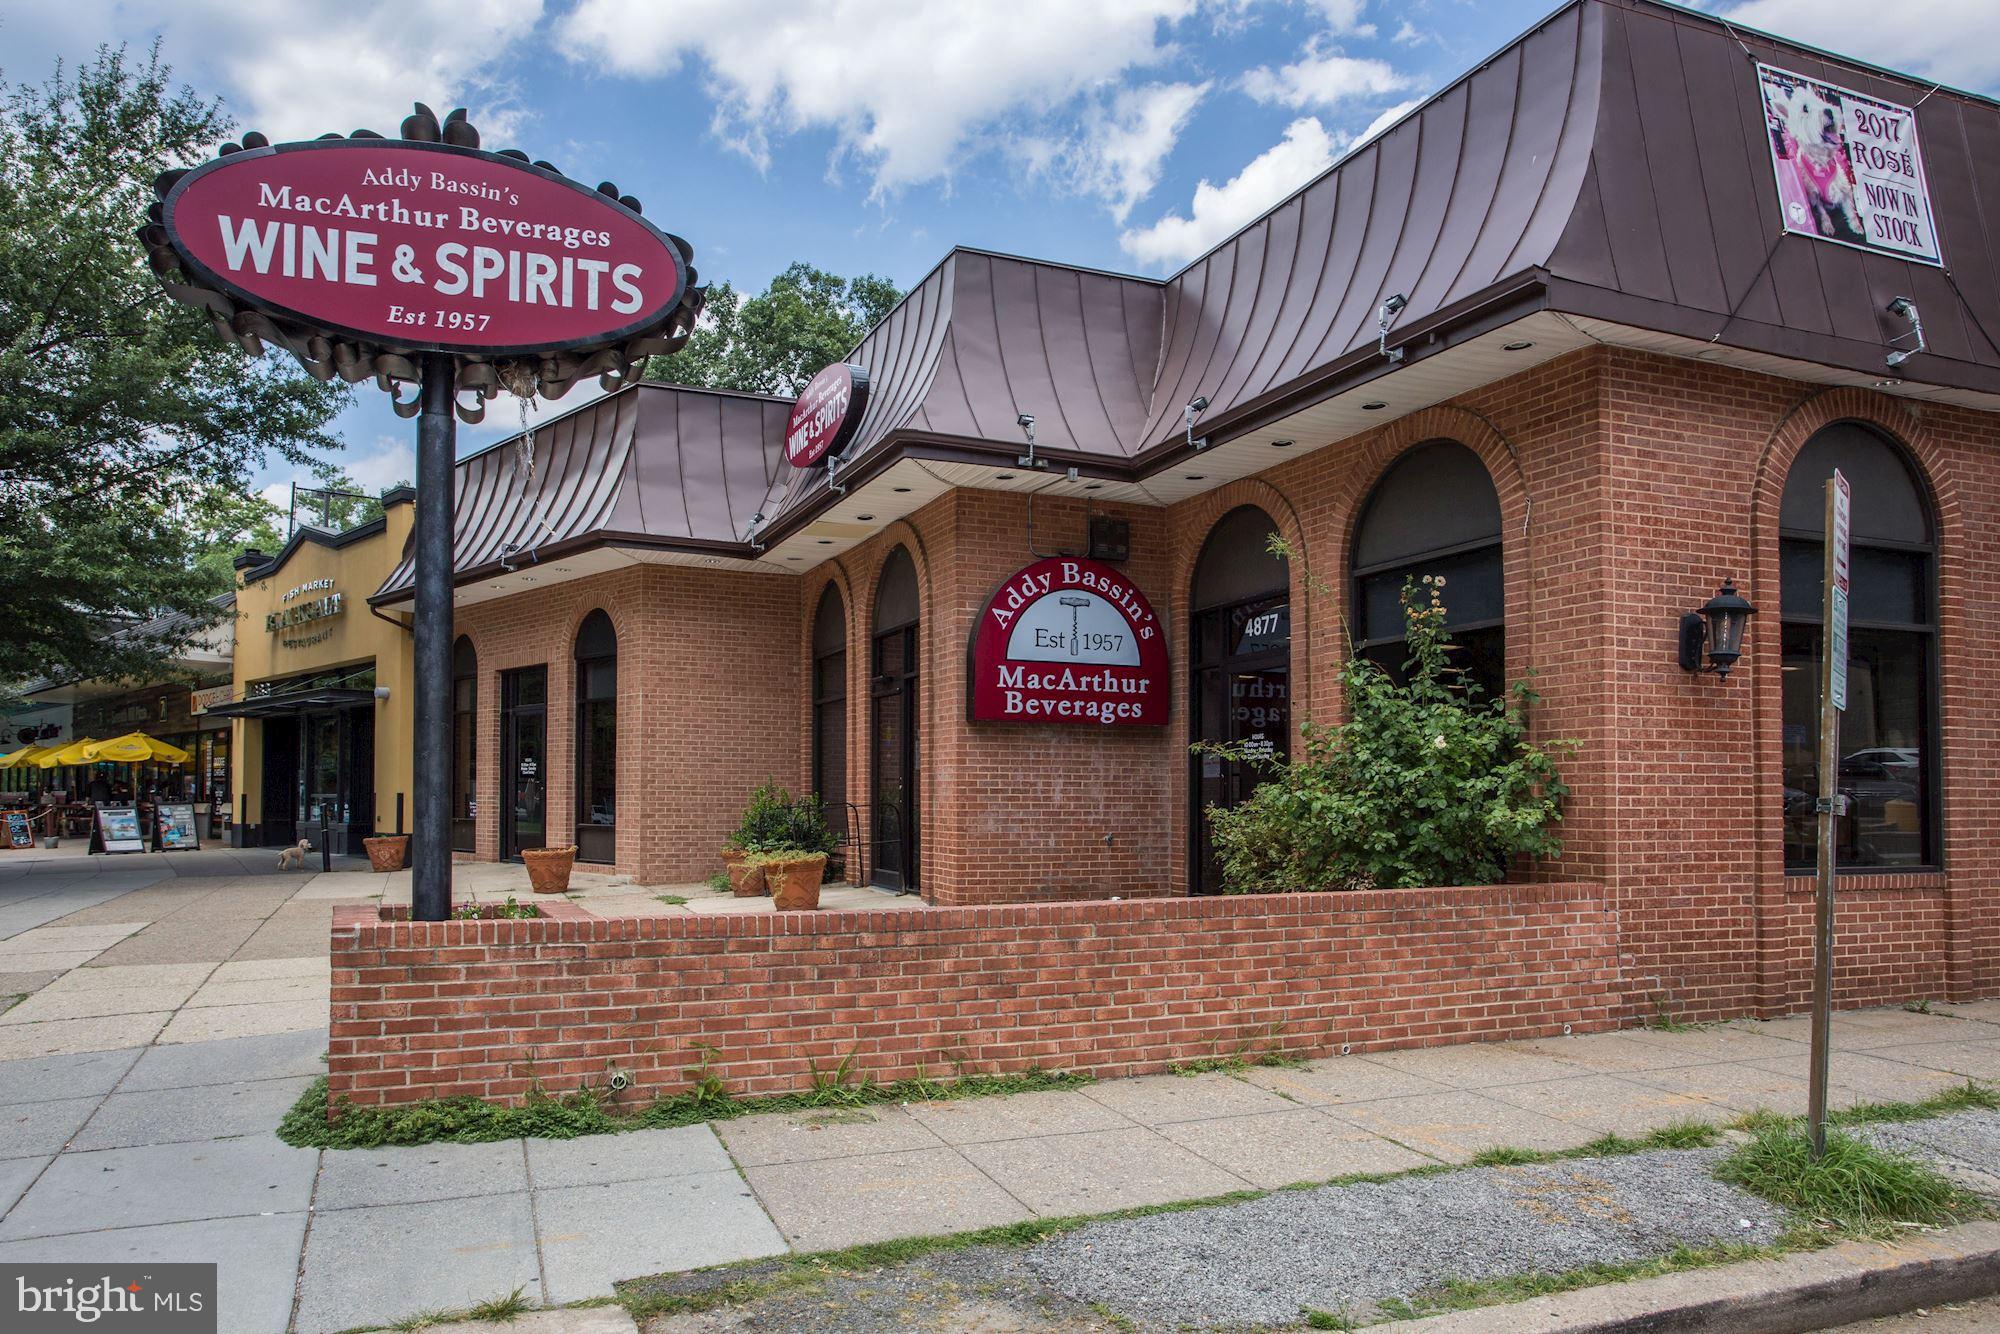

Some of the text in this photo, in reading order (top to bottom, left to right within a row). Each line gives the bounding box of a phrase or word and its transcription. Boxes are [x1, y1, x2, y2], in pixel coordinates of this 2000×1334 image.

[1854, 109, 1901, 142] 2017
[362, 168, 519, 206] Addy Bassin's
[1864, 182, 1919, 219] NOW IN
[258, 183, 611, 249] MacArthur Beverages
[1873, 213, 1923, 248] STOCK
[218, 214, 644, 315] WINE & SPIRITS
[387, 305, 491, 332] Est 1957
[788, 421, 809, 460] WINE
[809, 421, 815, 439] &
[814, 386, 848, 438] SPIRITS
[282, 579, 334, 602] FISH MARKET
[991, 562, 1154, 640] Addy Bassin's
[1034, 628, 1123, 652] Est 1957
[1245, 613, 1278, 637] 4877
[996, 665, 1149, 694] MacArthur
[1004, 691, 1142, 724] Beverages
